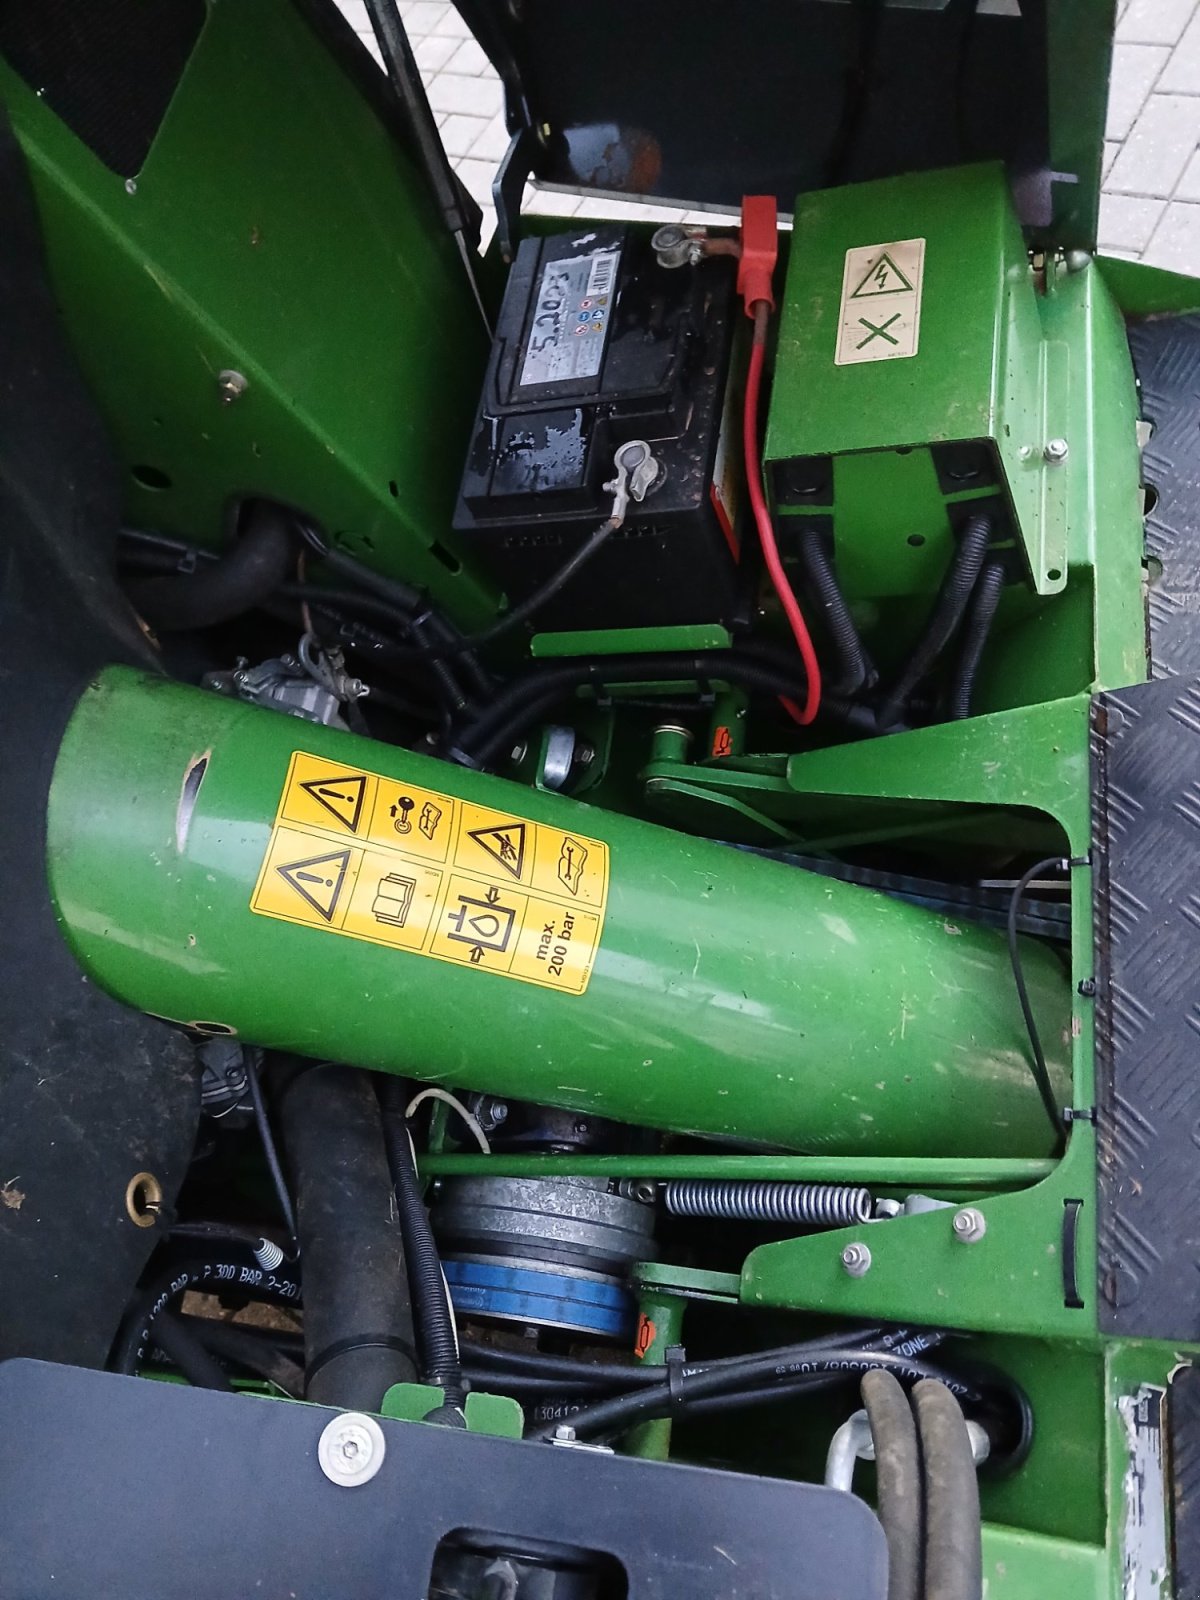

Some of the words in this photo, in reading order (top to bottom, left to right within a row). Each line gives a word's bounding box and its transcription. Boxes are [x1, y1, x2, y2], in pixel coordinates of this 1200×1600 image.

[535, 920, 555, 960] max.
[547, 945, 567, 977] 200
[557, 911, 575, 941] bar
[214, 1263, 236, 1280] 300
